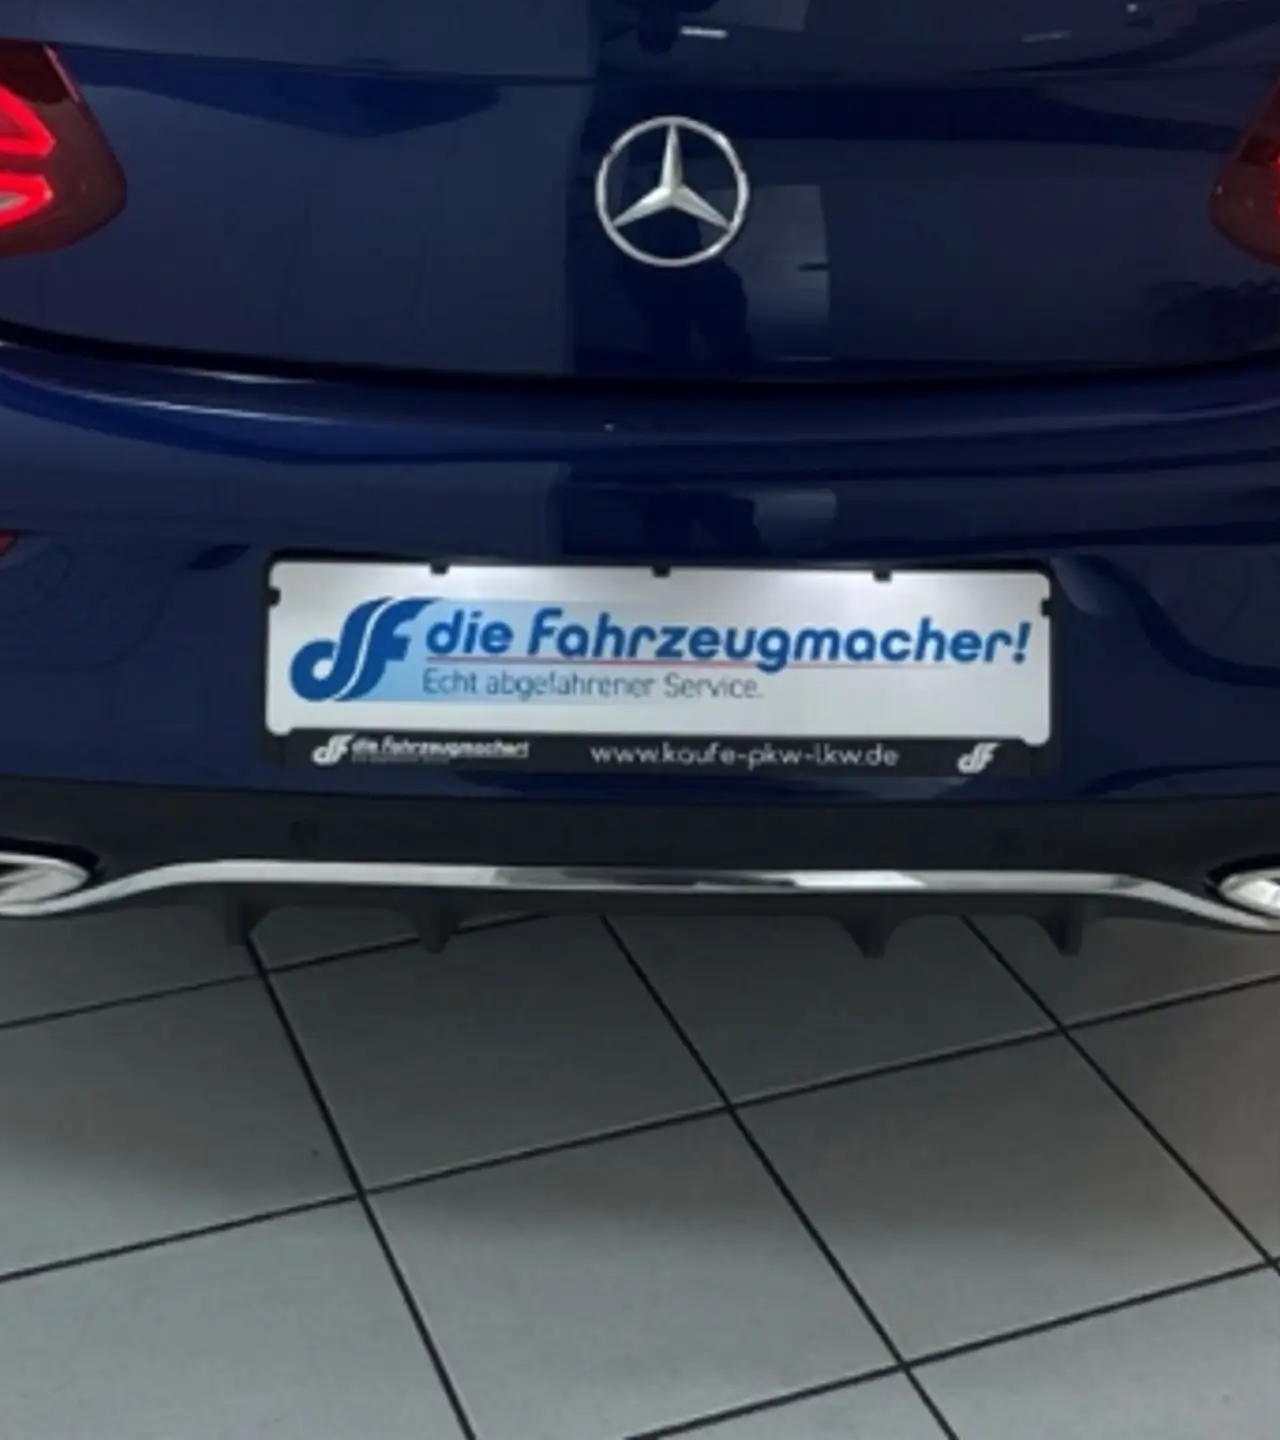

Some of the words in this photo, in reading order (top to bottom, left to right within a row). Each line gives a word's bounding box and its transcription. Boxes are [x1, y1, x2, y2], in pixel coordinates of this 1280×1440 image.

[426, 609, 514, 655] die
[527, 606, 1031, 674] Fahrzeugmacher!
[423, 667, 478, 695] Echt
[486, 668, 655, 702] abgefahrener
[664, 672, 764, 700] Service.
[590, 741, 900, 771] www.kaufe-pkw-lkw.de
